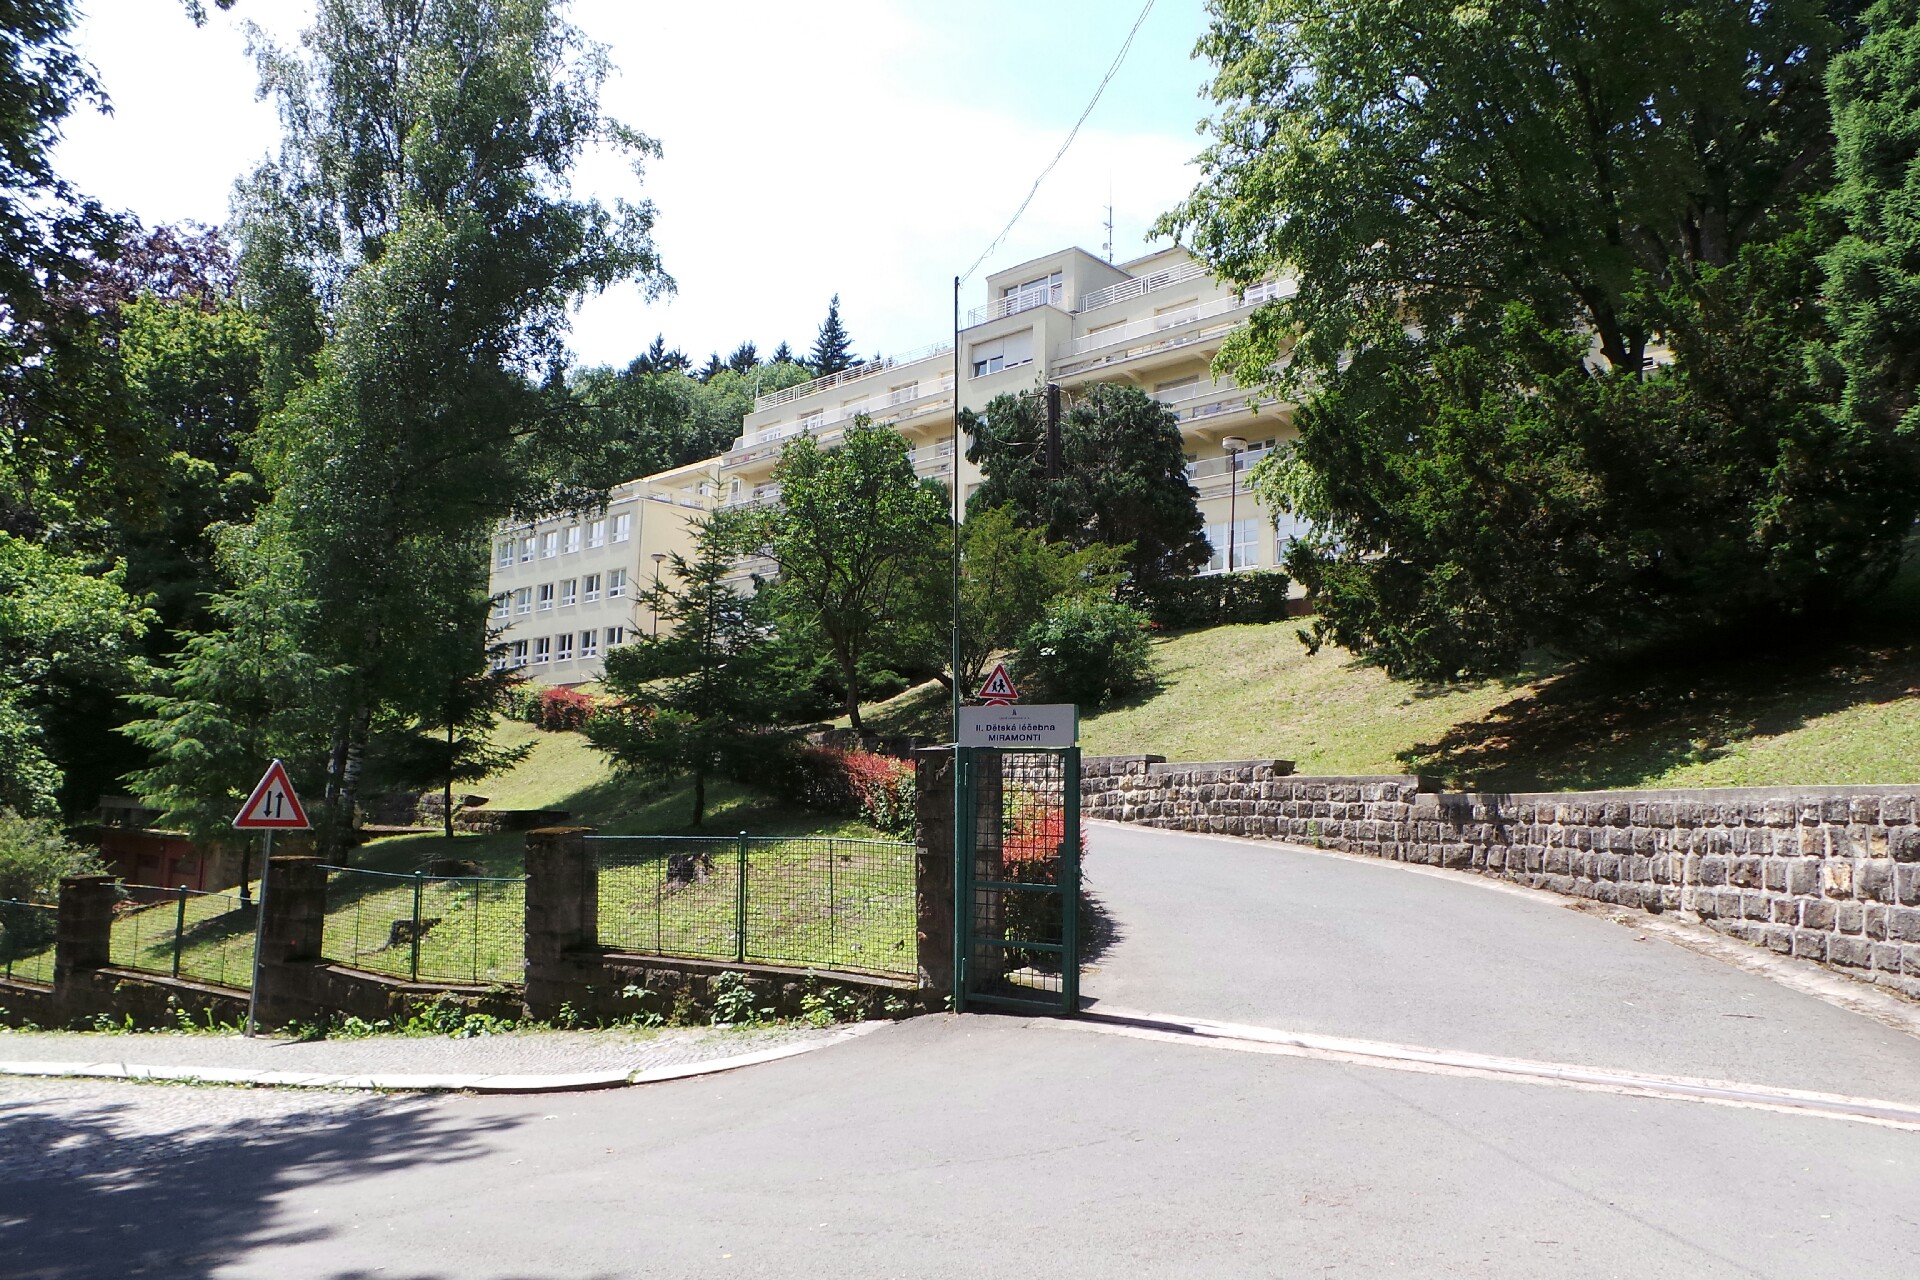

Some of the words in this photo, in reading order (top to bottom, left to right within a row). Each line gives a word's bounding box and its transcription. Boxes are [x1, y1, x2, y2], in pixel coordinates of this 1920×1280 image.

[975, 724, 984, 732] II.
[986, 723, 1017, 732] Dětská
[1018, 723, 1056, 732] léčebna
[988, 734, 1041, 742] MIRAMONTI
